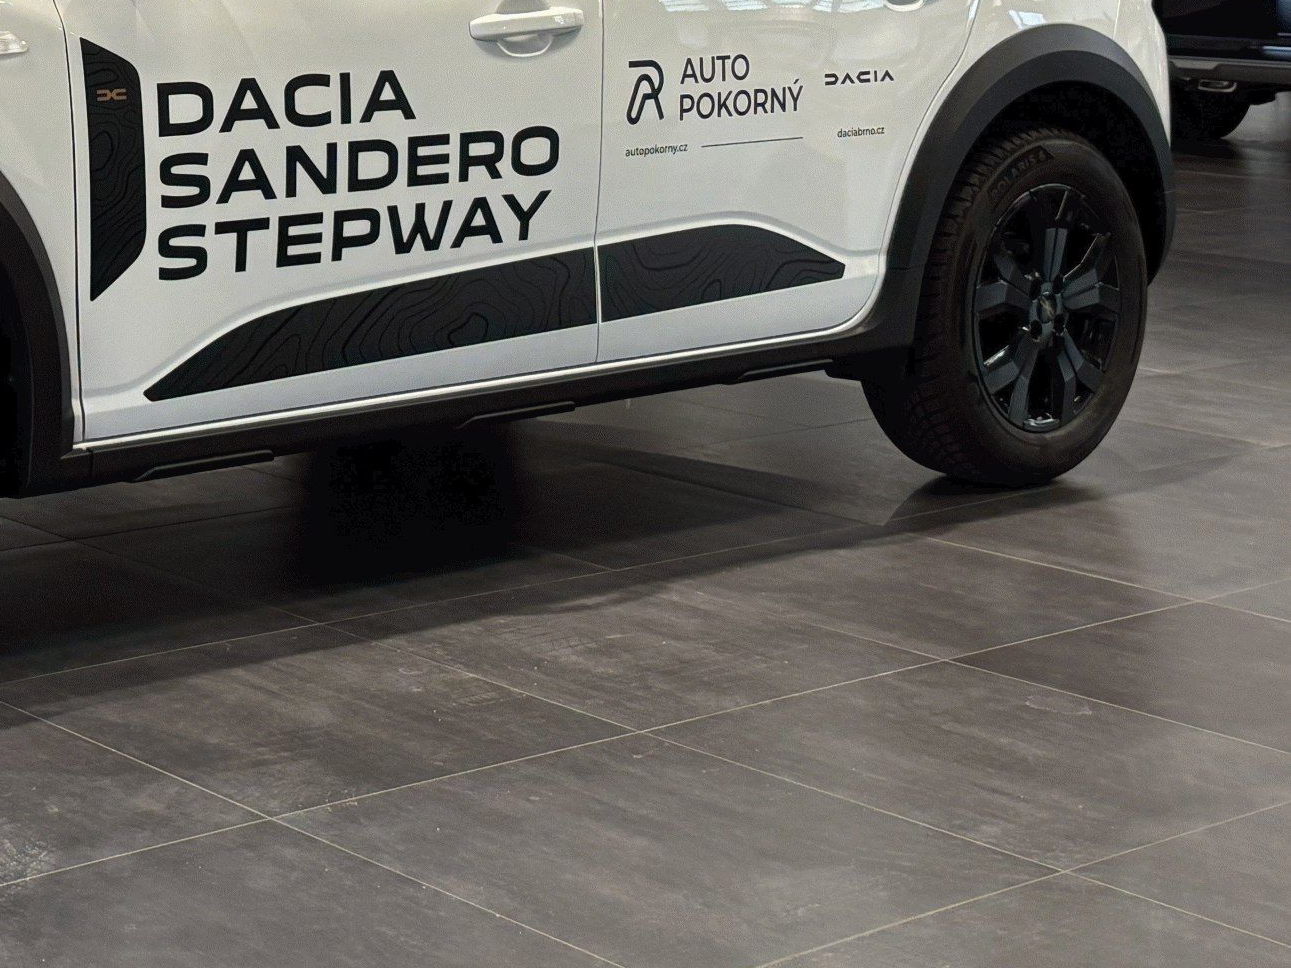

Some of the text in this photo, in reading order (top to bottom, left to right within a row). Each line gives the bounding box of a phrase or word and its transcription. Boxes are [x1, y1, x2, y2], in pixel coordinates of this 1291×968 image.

[680, 53, 750, 85] AUTO
[824, 69, 895, 86] DACIA
[156, 69, 416, 138] DACIA
[679, 78, 804, 121] POKORNÝ
[625, 143, 688, 158] autopokorny.cz
[836, 125, 885, 139] daciabrno.cz
[158, 125, 560, 209] SANDERO
[157, 189, 552, 281] STEPWAY
